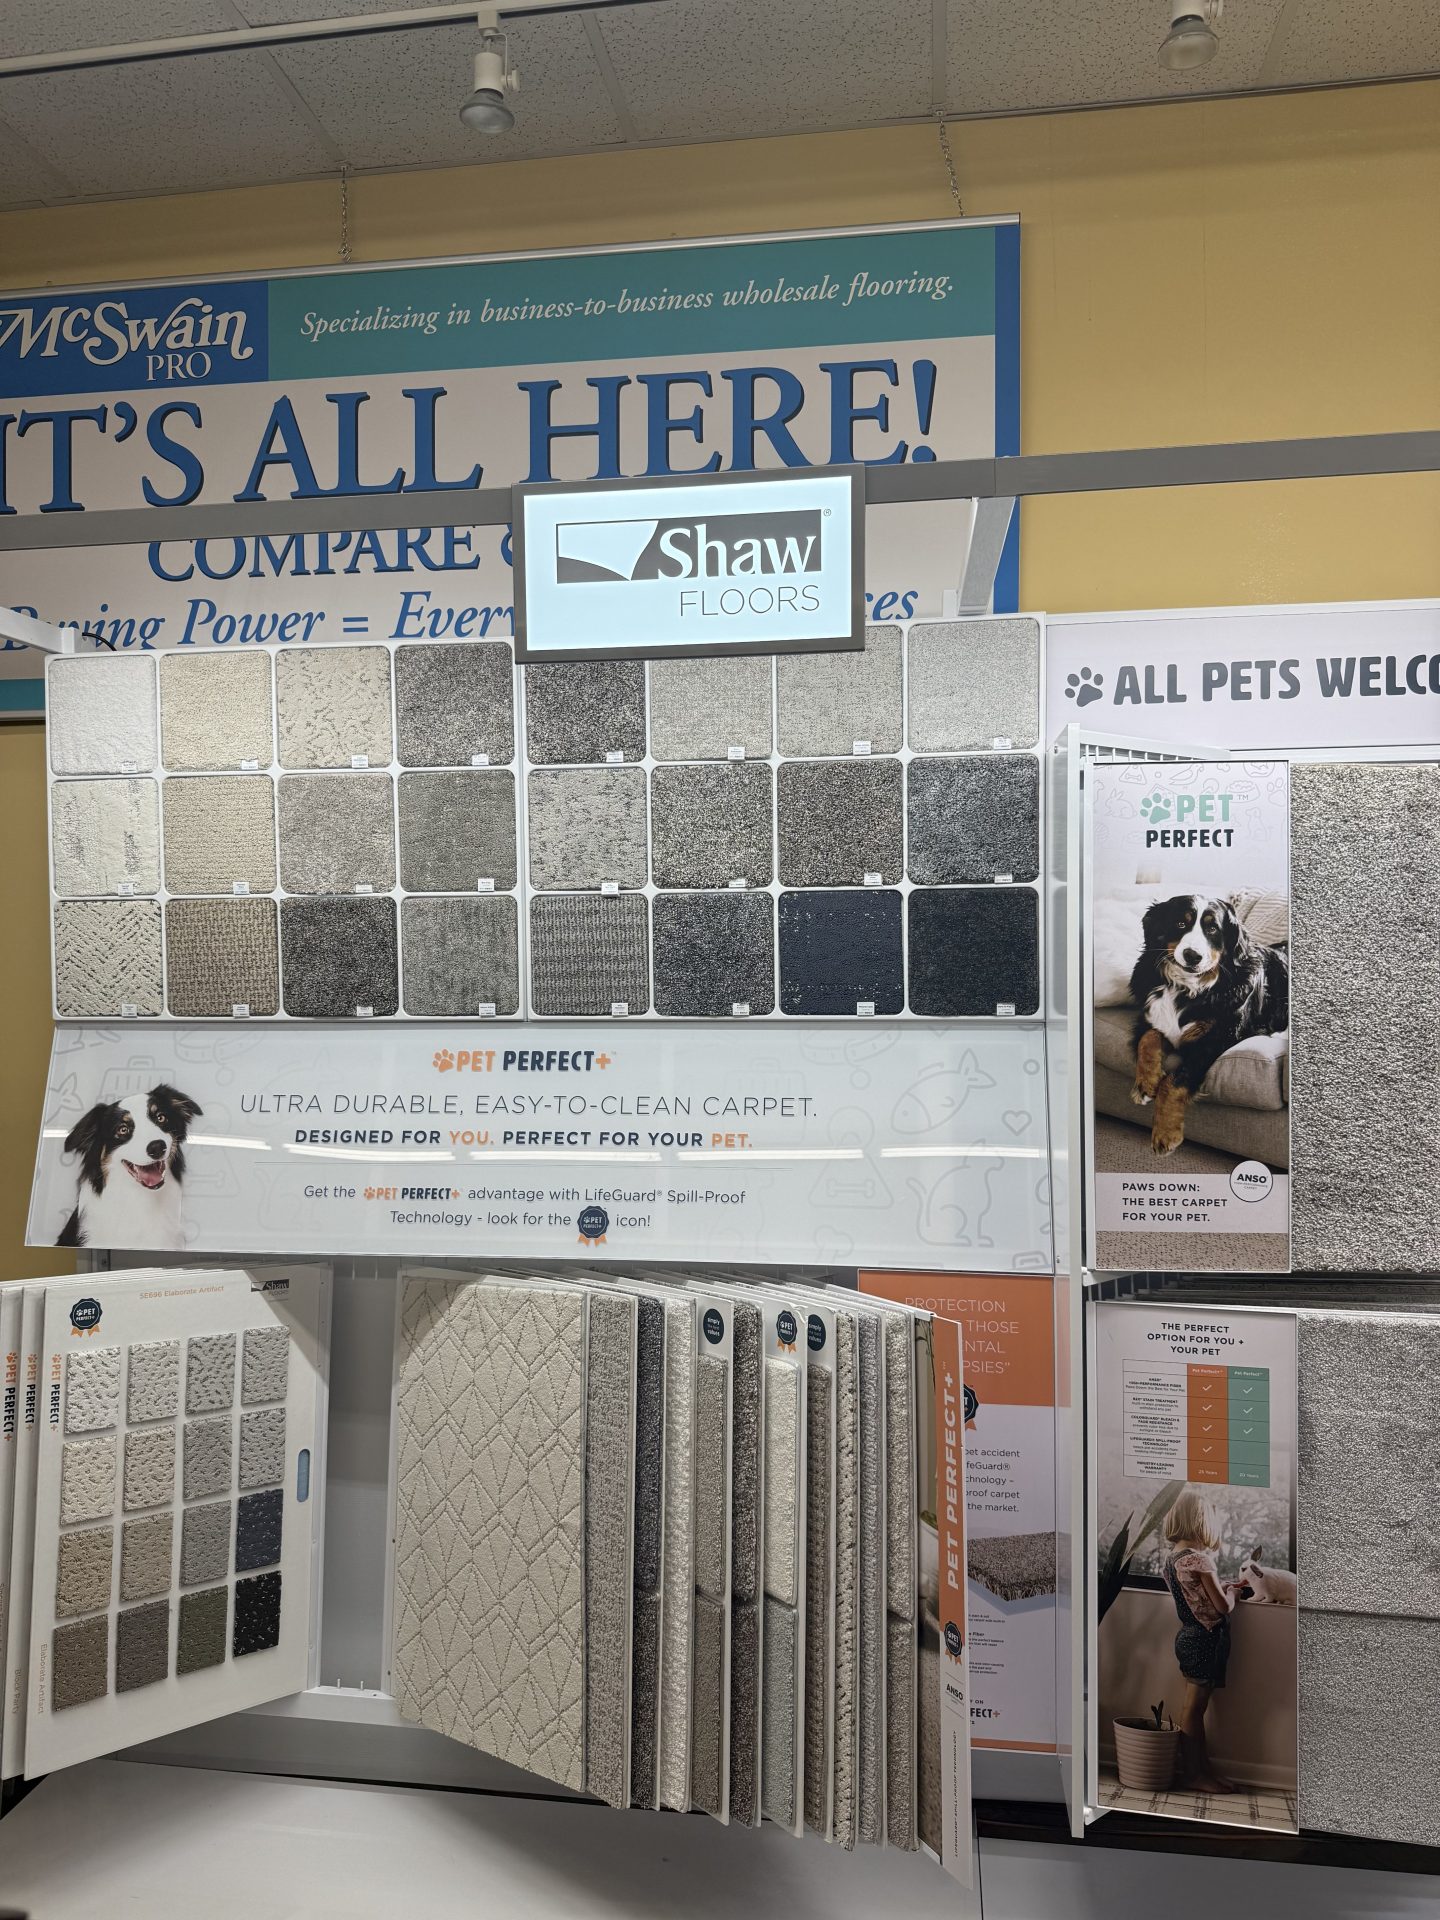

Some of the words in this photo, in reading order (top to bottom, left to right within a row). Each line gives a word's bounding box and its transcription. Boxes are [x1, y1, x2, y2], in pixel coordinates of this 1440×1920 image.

[300, 306, 440, 343] Specializing
[447, 302, 471, 325] in
[480, 288, 713, 323] business-to-business
[722, 274, 840, 306] wholesale
[842, 270, 953, 306] flooring.
[0, 297, 253, 365] McSwain
[146, 351, 211, 382] PRO
[234, 386, 484, 502] ALL
[518, 358, 937, 484] HERE!
[148, 526, 481, 582] COMPARE
[658, 523, 817, 579] Shaw
[680, 584, 820, 617] FLOORS
[177, 598, 325, 645] Power
[1113, 664, 1187, 705] ALL
[1202, 659, 1300, 702] PETS
[1176, 794, 1234, 822] PET
[1146, 829, 1234, 848] PERFECT
[457, 1050, 496, 1072] PET
[240, 1094, 322, 1113] ULTRA
[334, 1094, 463, 1115] DURABLE,
[475, 1095, 691, 1115] EASY-TO-CLEAN
[703, 1096, 817, 1117] CARPET.
[295, 1130, 393, 1144] DESIGNED
[401, 1131, 441, 1144] FOR
[449, 1130, 494, 1145] YOU.
[503, 1131, 591, 1145] PERFECT
[599, 1132, 639, 1145] FOR
[648, 1132, 703, 1146] YOUR
[711, 1133, 752, 1148] PET.
[1237, 1173, 1267, 1183] ANSO
[304, 1185, 328, 1198] Get
[333, 1185, 356, 1198] the
[376, 1187, 397, 1200] PET
[468, 1187, 544, 1203] advantage
[549, 1188, 580, 1201] with
[667, 1190, 747, 1205] Spill-Proof
[1122, 1182, 1155, 1192] PAWS
[1159, 1183, 1200, 1192] DOWN:
[1122, 1197, 1145, 1206] THE
[1148, 1198, 1177, 1206] BEST
[1181, 1198, 1228, 1207] CARPET
[390, 1210, 472, 1226] Technology
[487, 1211, 517, 1225] look
[523, 1212, 544, 1225] for
[548, 1212, 572, 1225] the
[616, 1214, 651, 1227] icon!
[1122, 1212, 1146, 1221] FOR
[1150, 1213, 1182, 1221] YOUR
[1186, 1213, 1210, 1222] PET.
[164, 1287, 197, 1297] Elaborate
[905, 1297, 1006, 1313] PROTECTION
[966, 1320, 1020, 1334] THOSE
[1161, 1322, 1181, 1331] THE
[1184, 1323, 1230, 1334] PERFECT
[1147, 1333, 1186, 1343] OPTION
[1189, 1335, 1210, 1344] FOR
[1213, 1336, 1235, 1346] YOU
[1170, 1345, 1199, 1355] YOUR
[1201, 1347, 1221, 1356] PET
[6, 1364, 16, 1383] PET
[27, 1364, 37, 1380] PET
[52, 1364, 61, 1381] PET
[981, 1449, 1020, 1457] accident
[990, 1491, 1020, 1499] carpet
[985, 1504, 1020, 1512] market.
[947, 1531, 959, 1591] PET
[946, 1683, 963, 1700] ANSO
